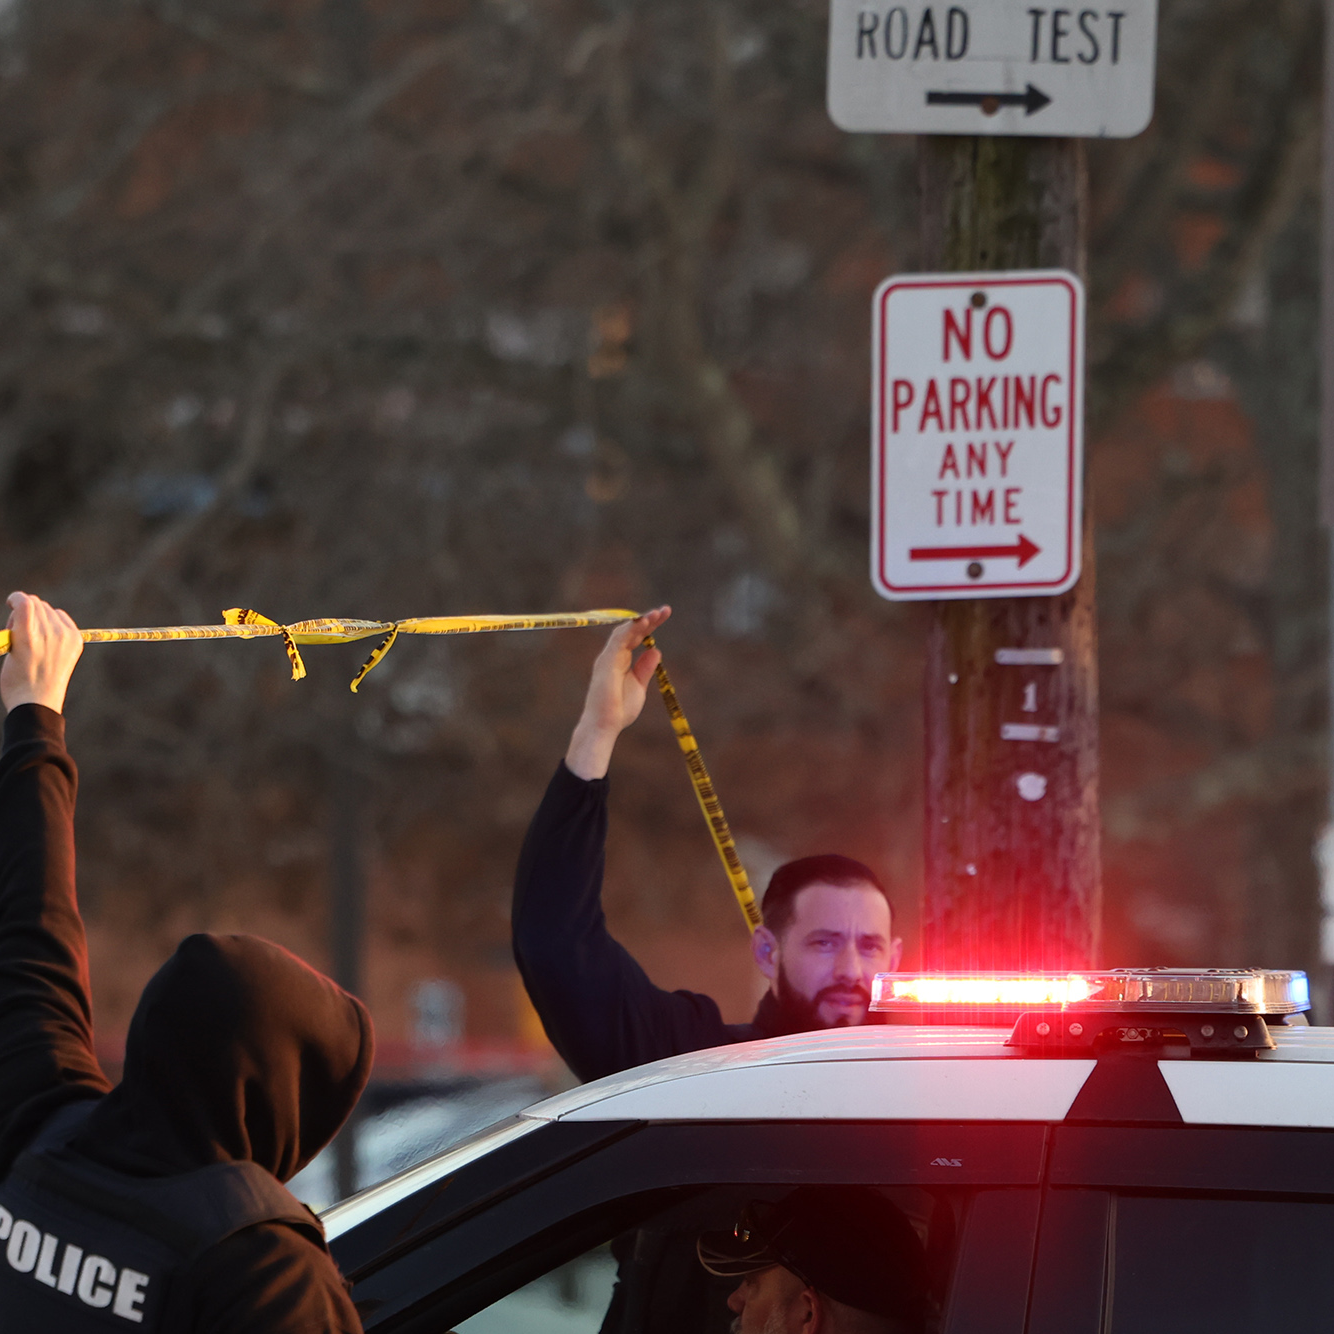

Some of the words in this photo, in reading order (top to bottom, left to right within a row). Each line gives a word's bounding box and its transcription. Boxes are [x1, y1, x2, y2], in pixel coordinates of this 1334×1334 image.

[856, 8, 969, 60] ROAD
[1028, 8, 1128, 65] TEST
[941, 305, 1015, 363] NO
[891, 374, 1063, 434] PARKING
[938, 441, 1016, 480] ANY
[931, 488, 1023, 527] TIME
